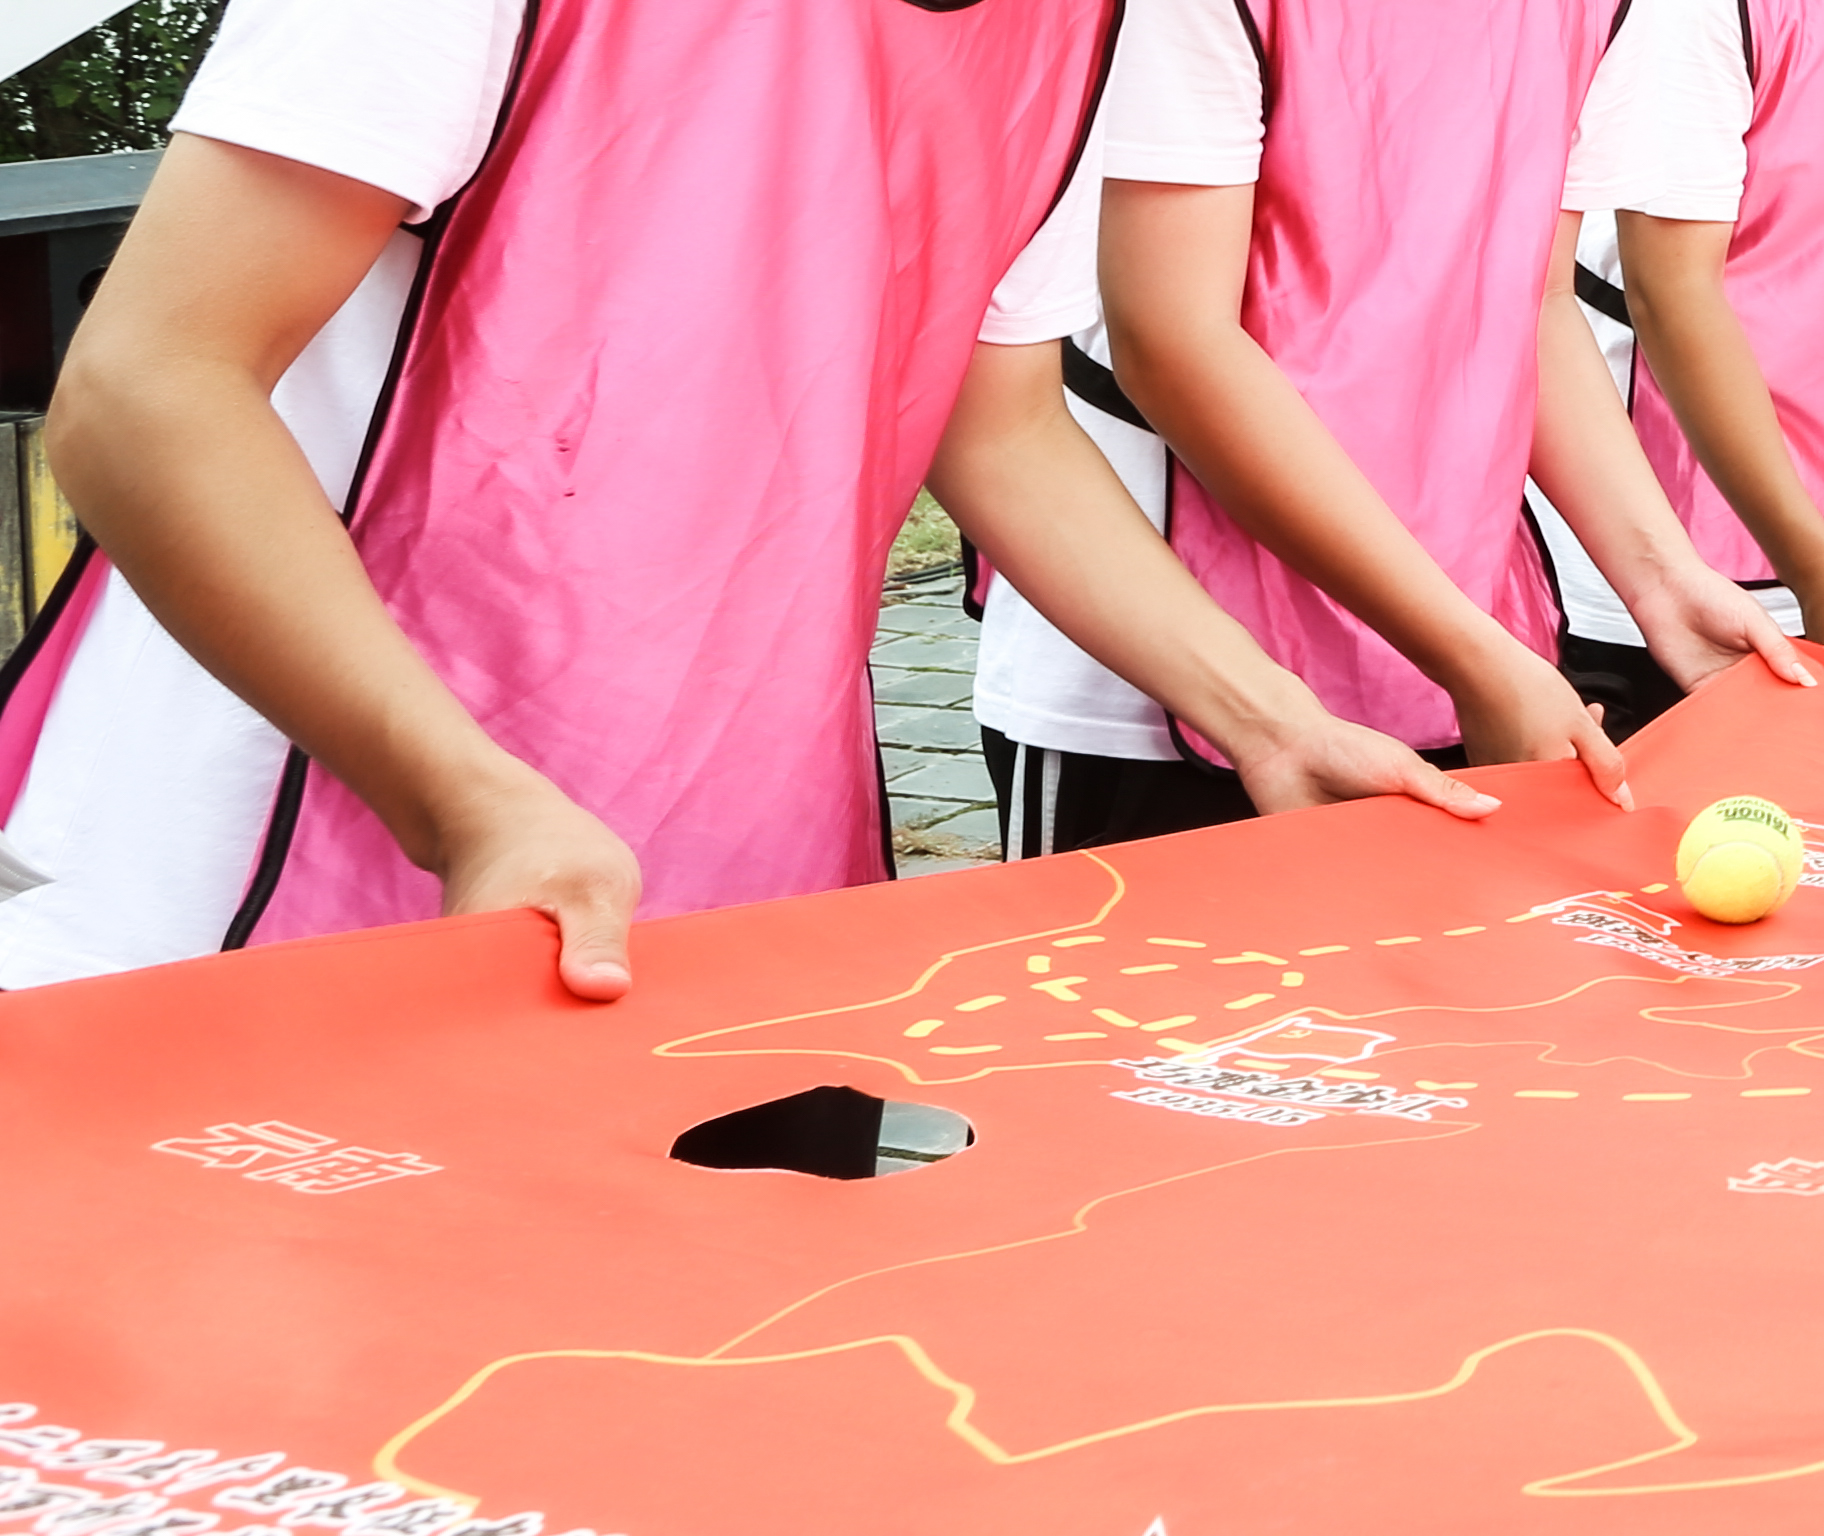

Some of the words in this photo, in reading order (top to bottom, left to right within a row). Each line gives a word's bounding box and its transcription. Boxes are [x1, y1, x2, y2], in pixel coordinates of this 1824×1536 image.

[1108, 1088, 1327, 1127] 1935.05
[1111, 1057, 1470, 1121] 巧渡金沙江
[149, 1120, 446, 1195] 云南
